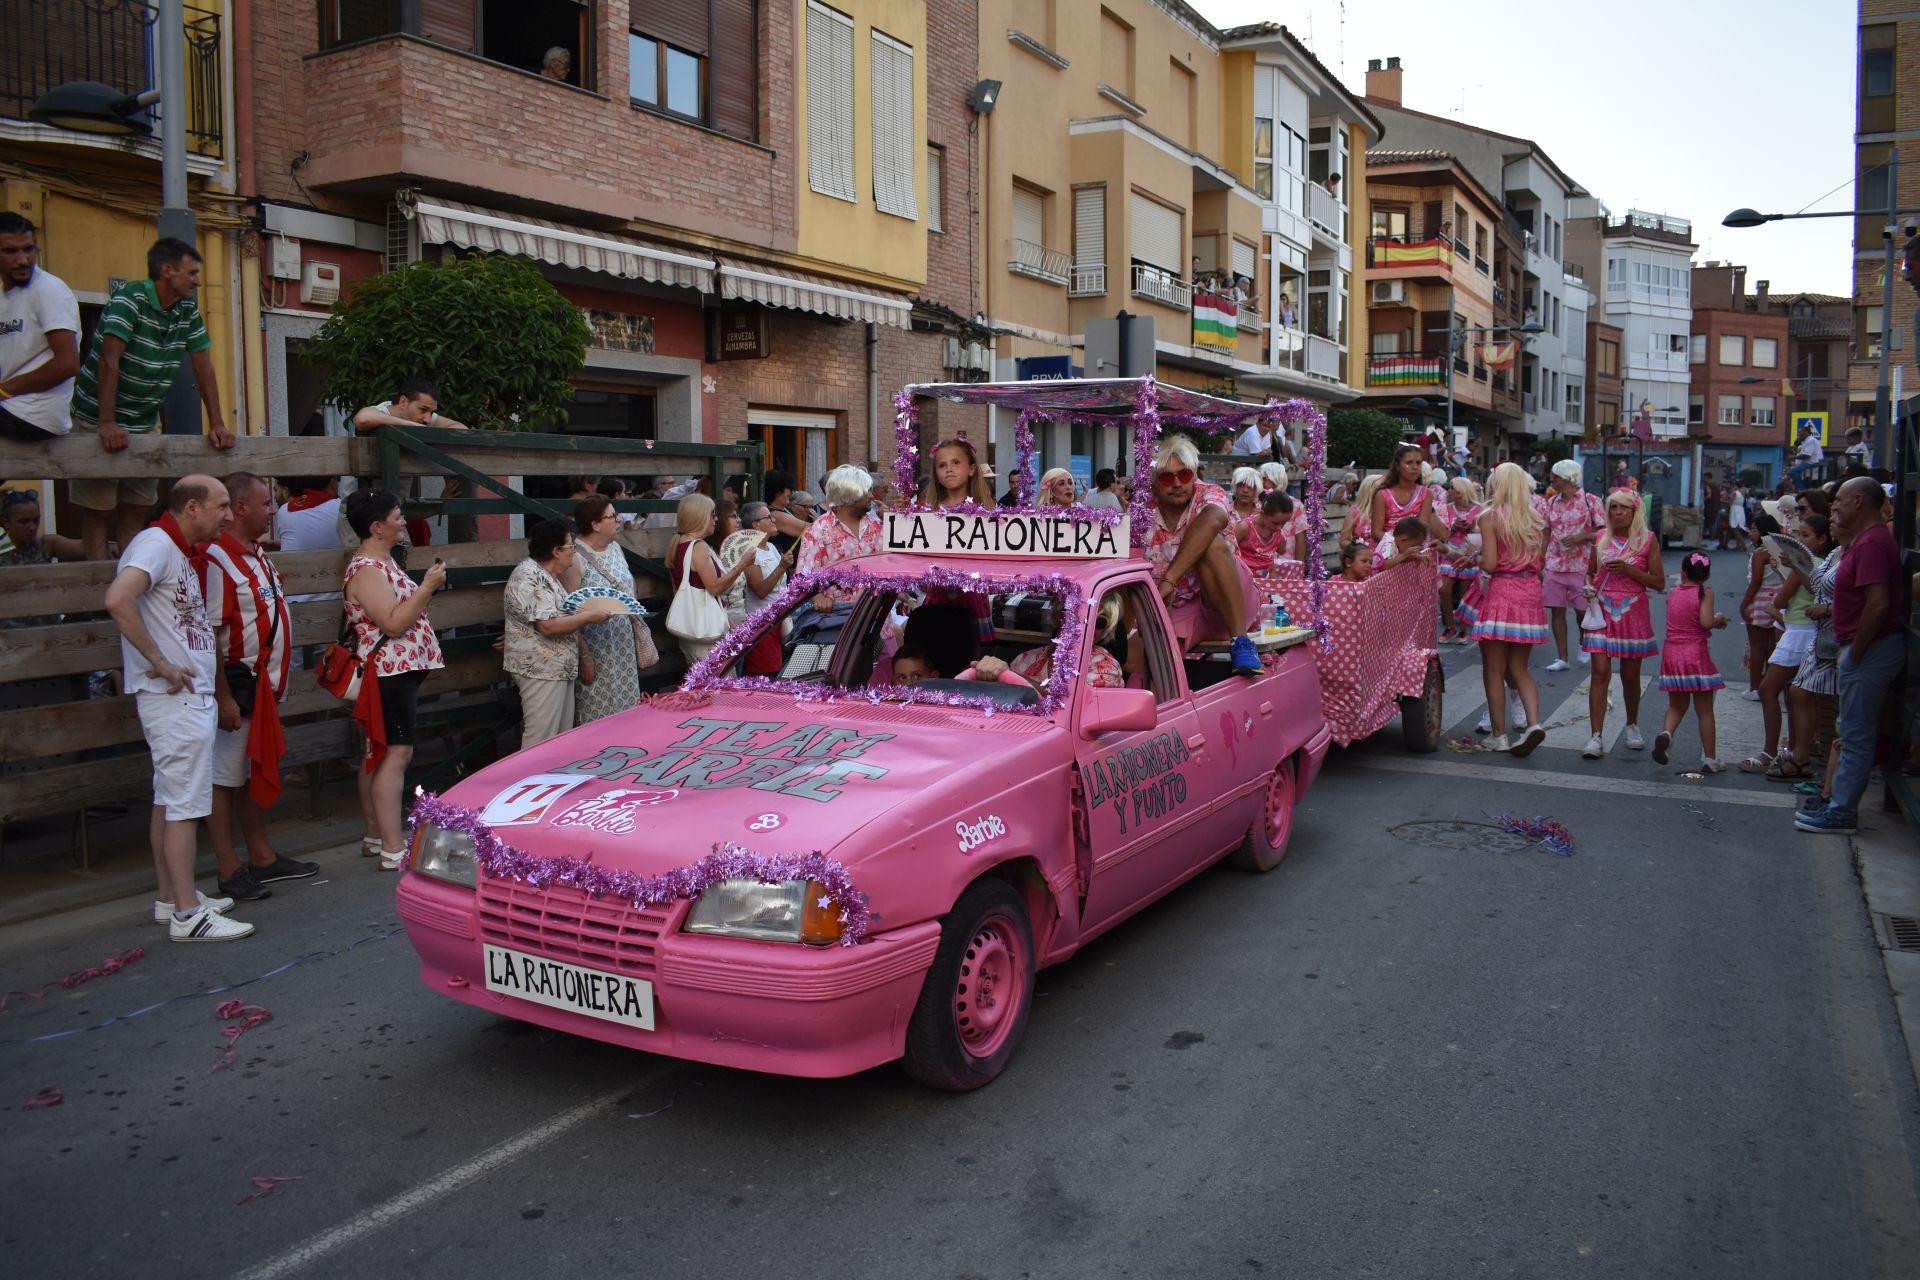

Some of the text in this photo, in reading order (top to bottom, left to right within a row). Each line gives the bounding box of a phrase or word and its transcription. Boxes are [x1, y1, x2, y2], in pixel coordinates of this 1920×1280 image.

[726, 341, 757, 351] ALHAMBRA
[727, 332, 755, 342] CERVEZAS
[888, 515, 1118, 555] LA RATONERA
[666, 717, 898, 758] TEAM
[547, 745, 890, 803] BARBIE
[1083, 727, 1190, 810] LA RATONERA
[503, 783, 571, 804] 11
[1114, 772, 1188, 835] Y PUNTO
[551, 799, 637, 835] Barbie
[749, 813, 780, 830] B
[955, 814, 1006, 853] Barbie
[489, 950, 643, 1018] LA RATONERA
